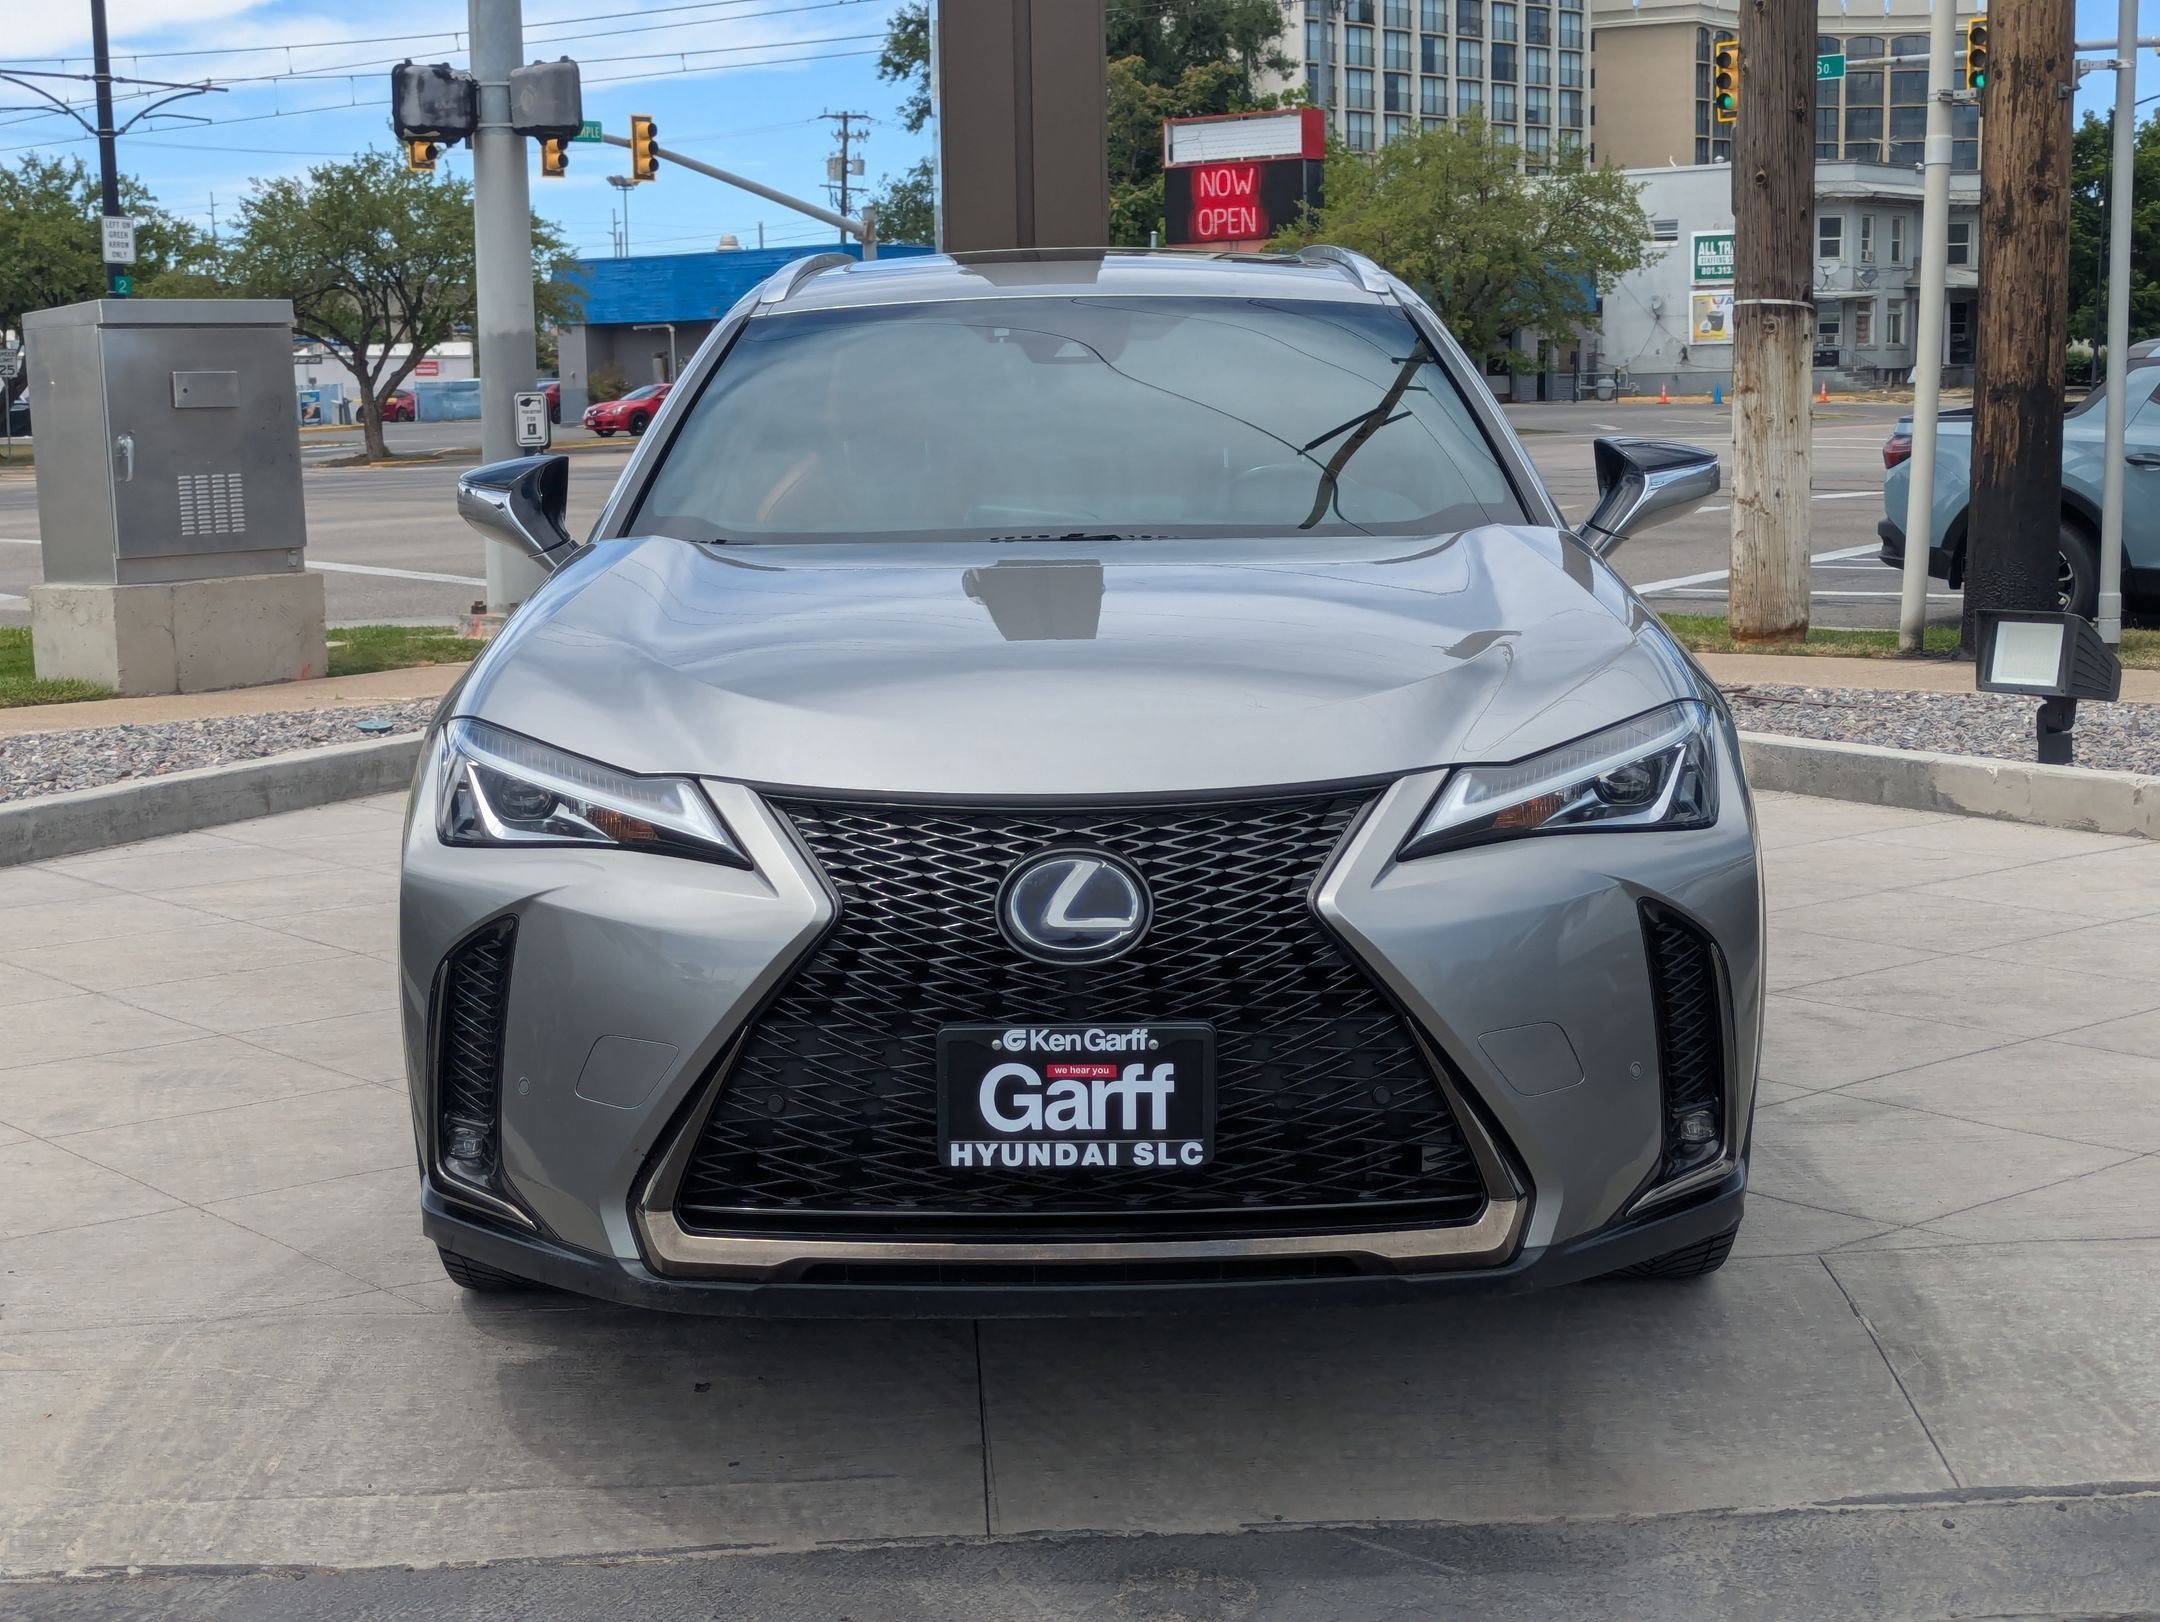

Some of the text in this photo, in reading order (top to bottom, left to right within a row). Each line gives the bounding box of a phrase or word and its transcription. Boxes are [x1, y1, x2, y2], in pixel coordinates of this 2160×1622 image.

[1200, 168, 1254, 197] NOW
[1198, 207, 1256, 236] OPEN
[1698, 241, 1717, 255] ALL
[119, 279, 127, 293] 2
[0, 365, 15, 375] 25
[1070, 1066, 1090, 1074] hear
[1092, 1067, 1109, 1076] you
[979, 1062, 1175, 1132] Garff
[950, 1142, 1204, 1167] HYUNDAI SLC
